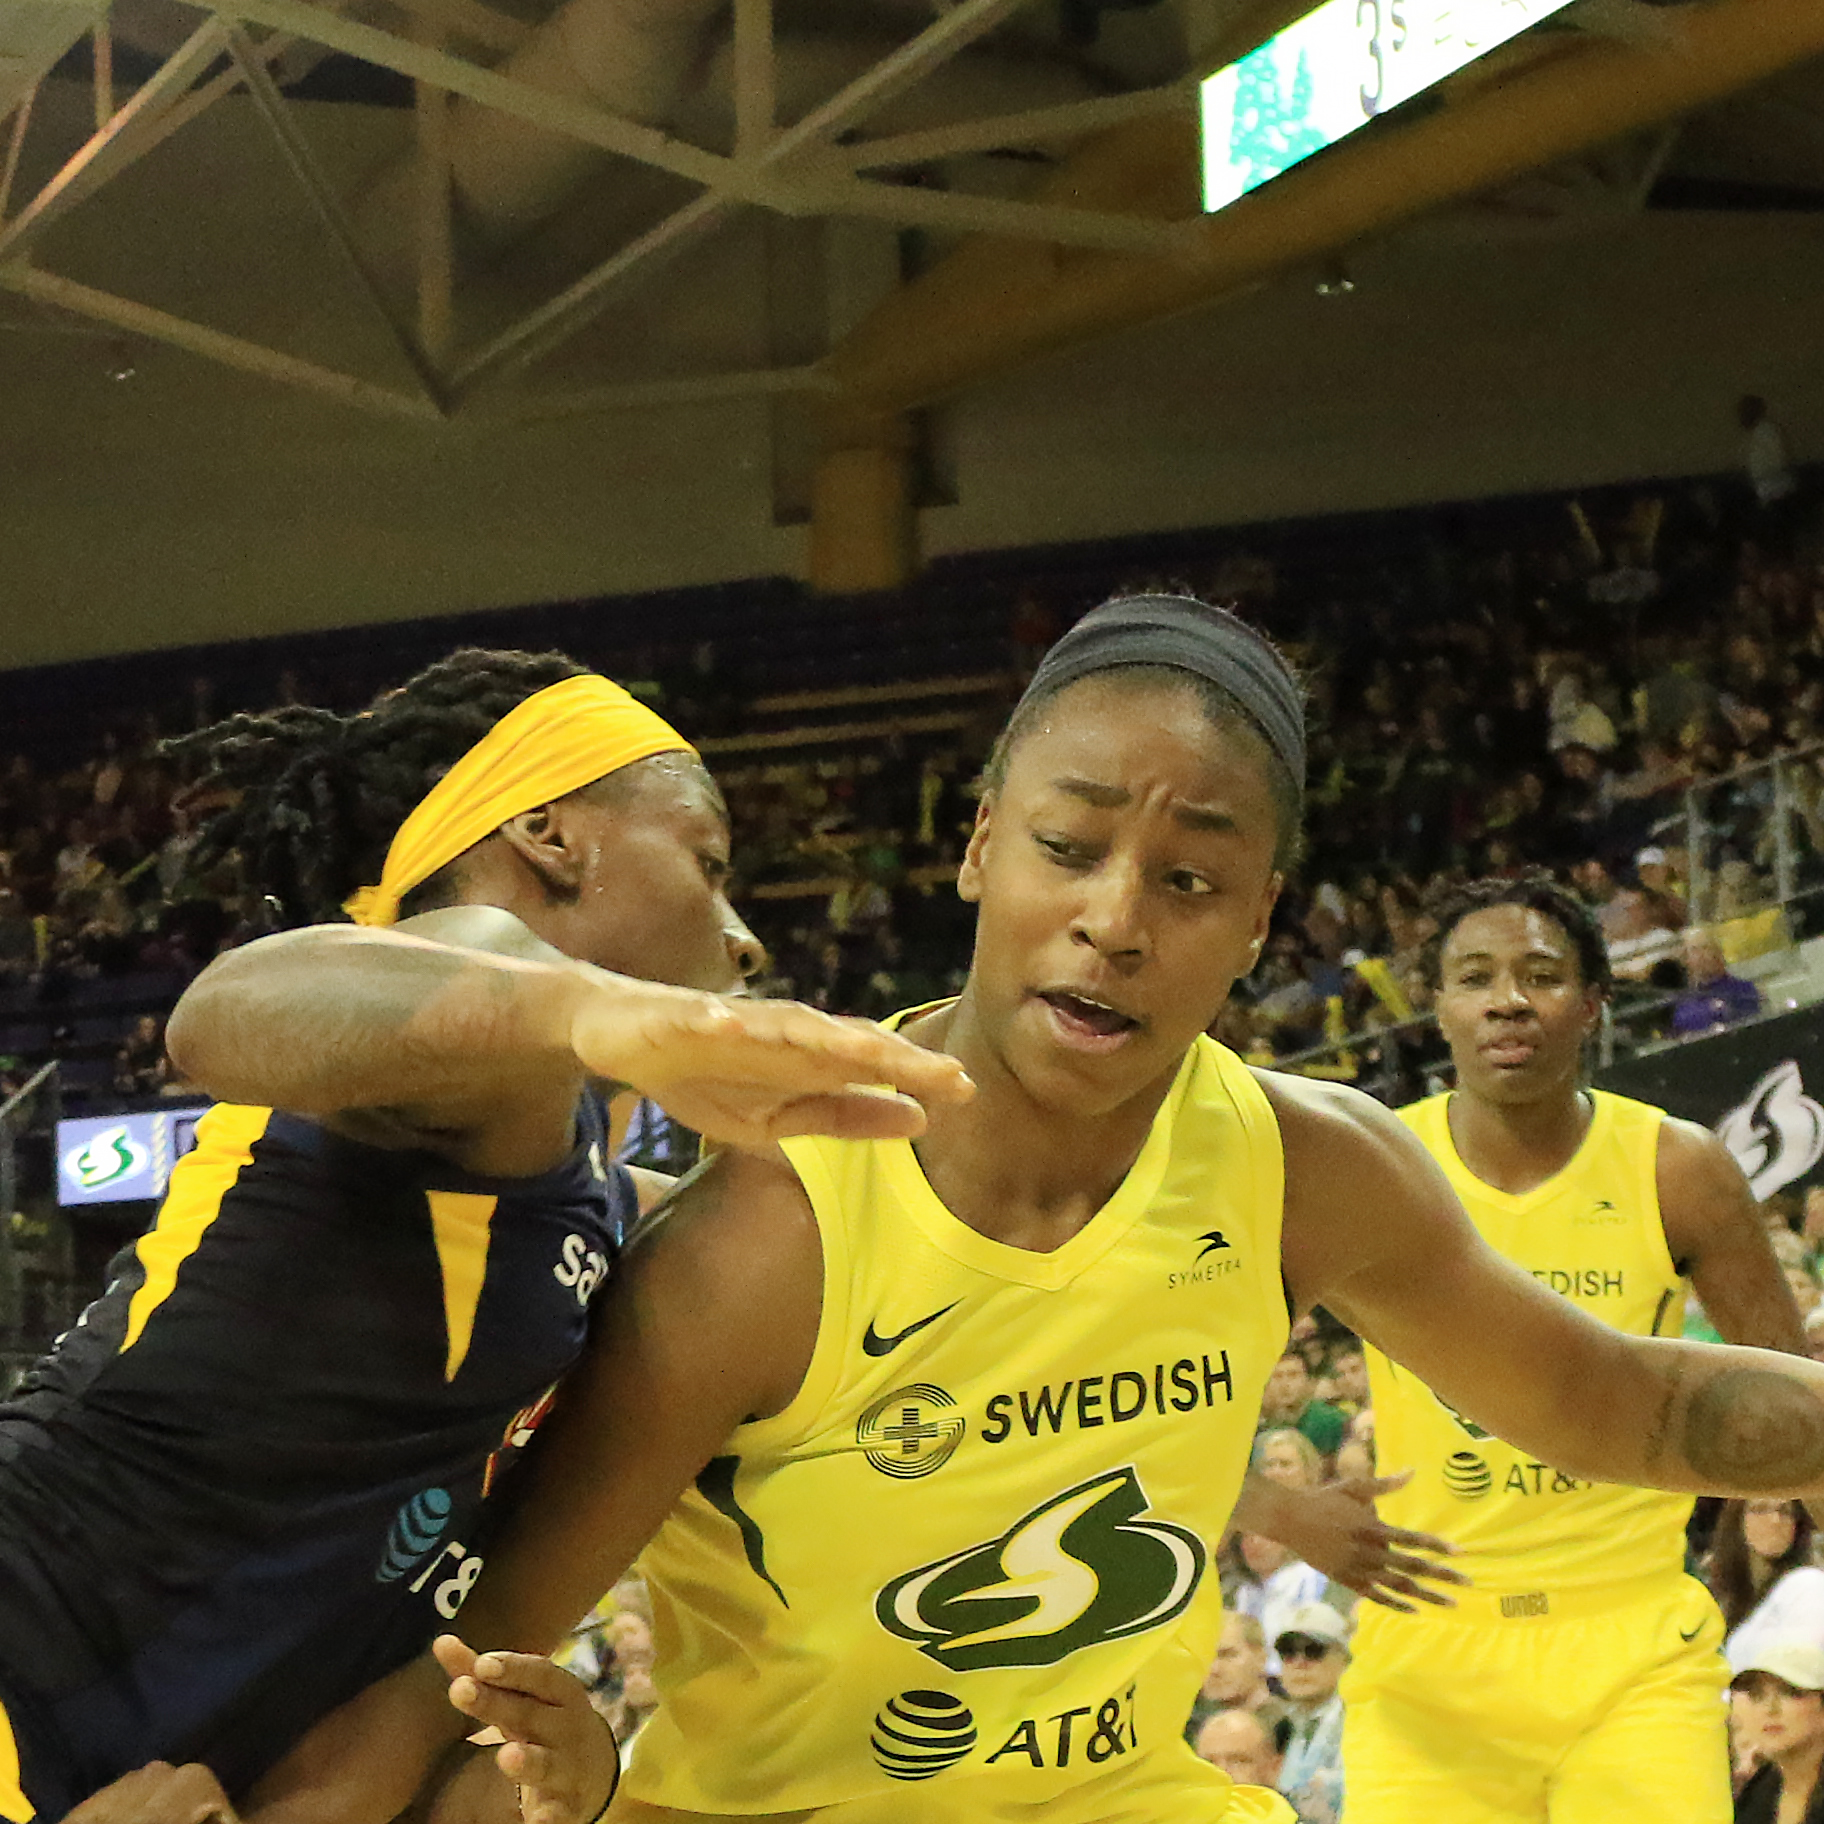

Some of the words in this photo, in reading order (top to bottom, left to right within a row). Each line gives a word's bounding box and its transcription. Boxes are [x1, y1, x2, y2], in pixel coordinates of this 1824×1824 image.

[1168, 1257, 1243, 1290] SYMETRA
[1533, 1269, 1624, 1298] DISH
[980, 1349, 1235, 1445] SWEDISH
[983, 1688, 1139, 1770] AT&T
